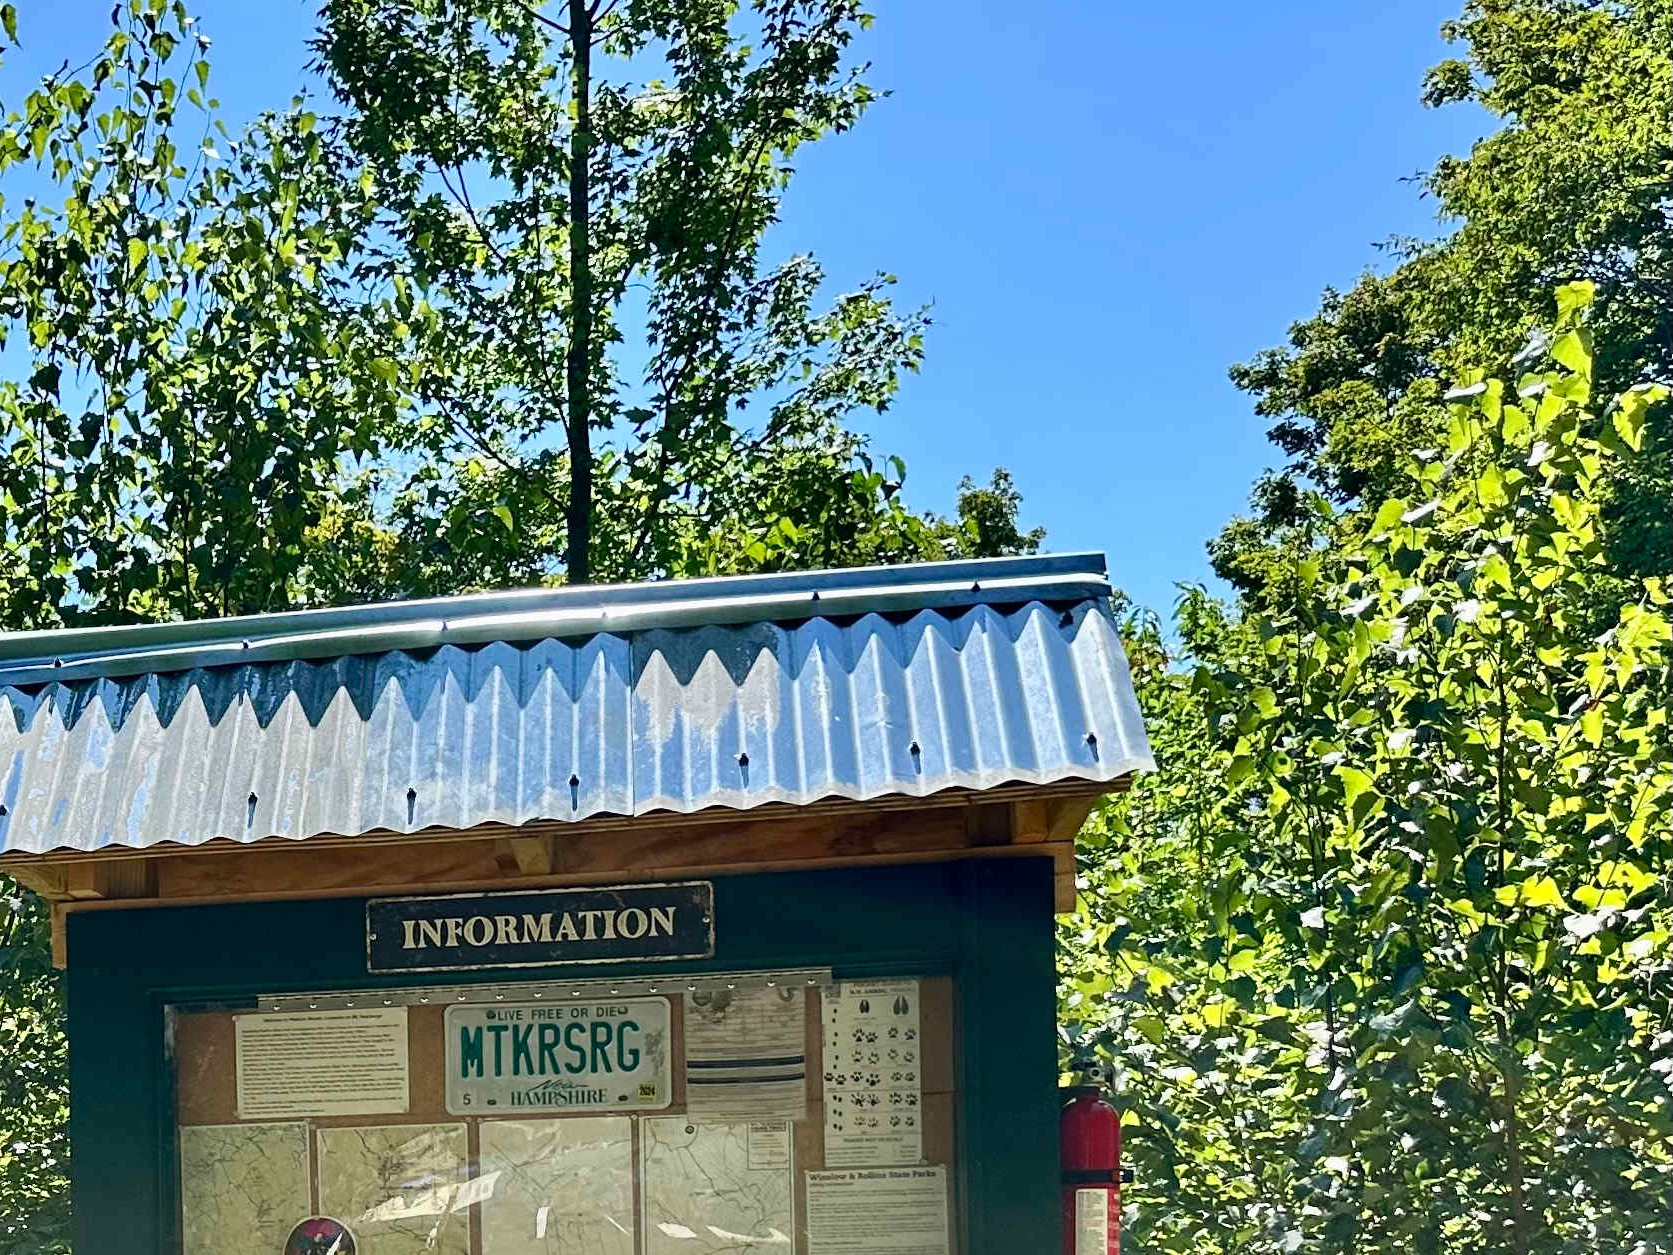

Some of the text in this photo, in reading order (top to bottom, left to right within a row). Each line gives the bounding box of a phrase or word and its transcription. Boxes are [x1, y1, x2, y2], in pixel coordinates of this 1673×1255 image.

[401, 906, 677, 949] INFORMATION
[497, 1006, 618, 1021] LIVE FREE OR DIE
[460, 1020, 641, 1079] MTKRSRG
[462, 1093, 471, 1106] 5
[510, 1088, 608, 1107] HAMPSHIRE
